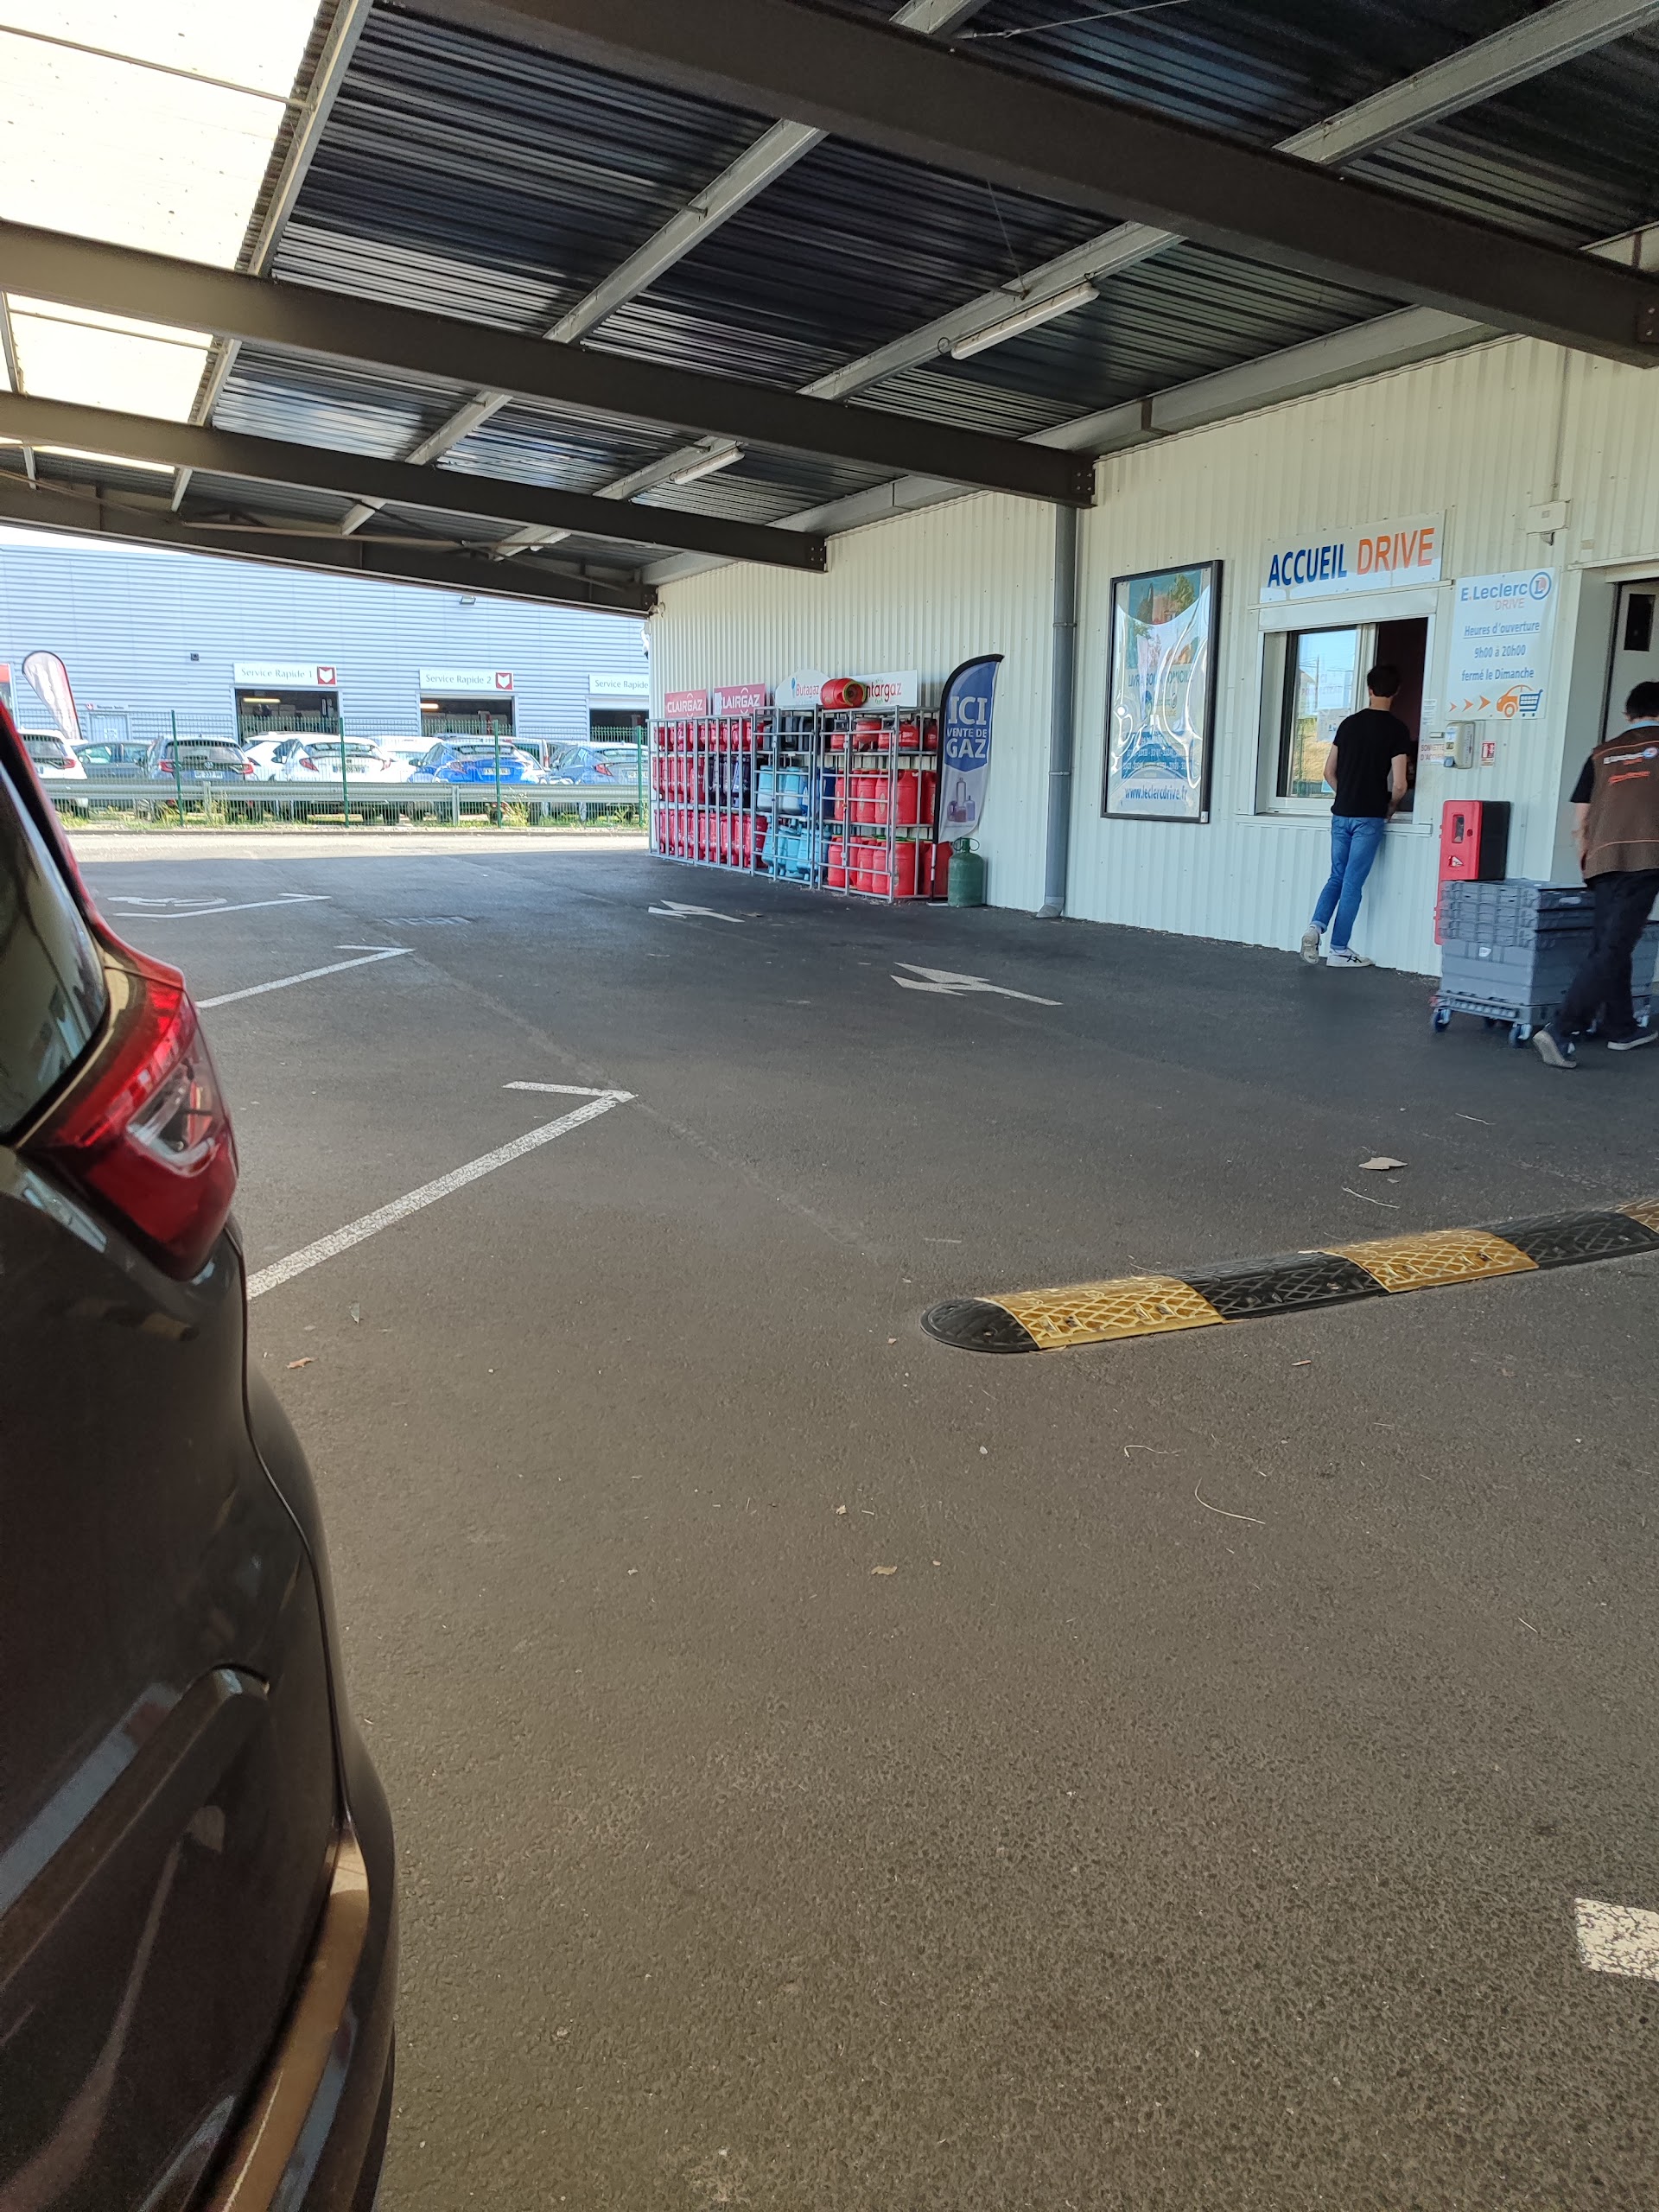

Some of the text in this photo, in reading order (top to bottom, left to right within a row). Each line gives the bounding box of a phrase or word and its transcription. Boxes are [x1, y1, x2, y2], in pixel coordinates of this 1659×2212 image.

[1268, 527, 1435, 588] ACCUEIL DRIVE
[1460, 582, 1528, 601] E.Leclerc
[1495, 598, 1525, 611] DRIVE
[1465, 621, 1541, 637] Heures d'ouverture
[1474, 646, 1493, 658] 9h00
[1502, 645, 1527, 657] 20h00
[241, 668, 272, 677] Service
[275, 669, 306, 679] Rapide
[425, 673, 454, 683] Service
[456, 674, 485, 685] Rapide
[1462, 666, 1535, 681] fermé le Dimanche
[594, 679, 649, 690] Service Rapide
[796, 683, 820, 699] Butagaz
[866, 679, 902, 702] ntargaz
[667, 698, 703, 713] CLAIRGAZ
[721, 694, 760, 709] LAIRGAZ
[948, 696, 988, 725] ICI
[947, 727, 988, 738] VENTE DE
[946, 737, 987, 759] GAZ
[1124, 785, 1188, 800] www.leclercdrive.fr
